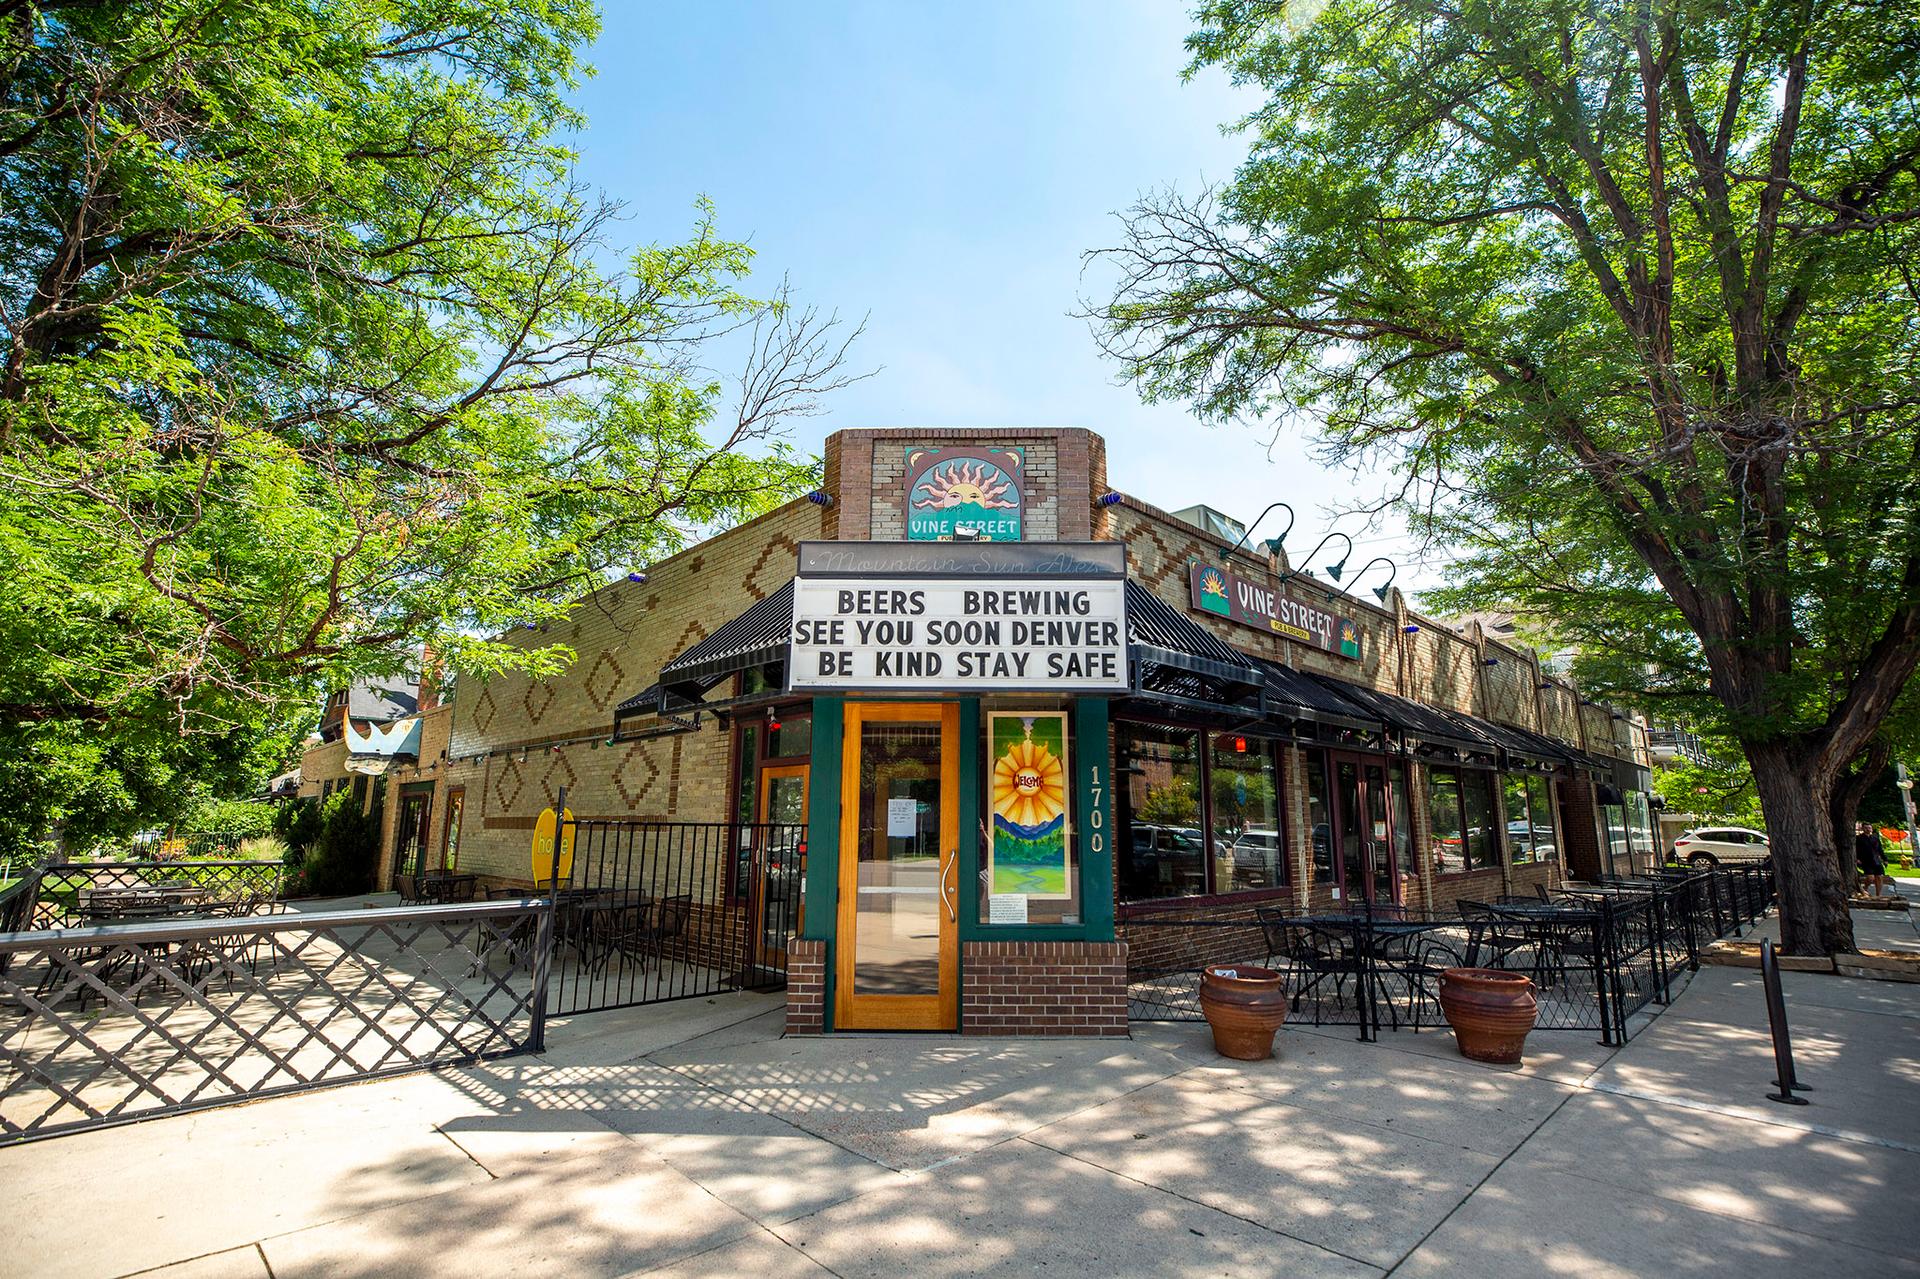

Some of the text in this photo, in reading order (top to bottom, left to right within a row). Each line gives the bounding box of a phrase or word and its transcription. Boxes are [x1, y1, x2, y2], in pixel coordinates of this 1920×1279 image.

[911, 520, 949, 533] VINE
[819, 551, 963, 572] Mountain
[973, 551, 1024, 573] Sun
[838, 590, 1090, 615] BEERS BREWING
[1237, 581, 1332, 638] VINE STREET
[795, 620, 1119, 647] SEE YOU SOON DENVER
[818, 651, 1116, 678] BE KIND STAY SAFE
[1091, 766, 1103, 852] 1700
[538, 833, 568, 854] hoe
